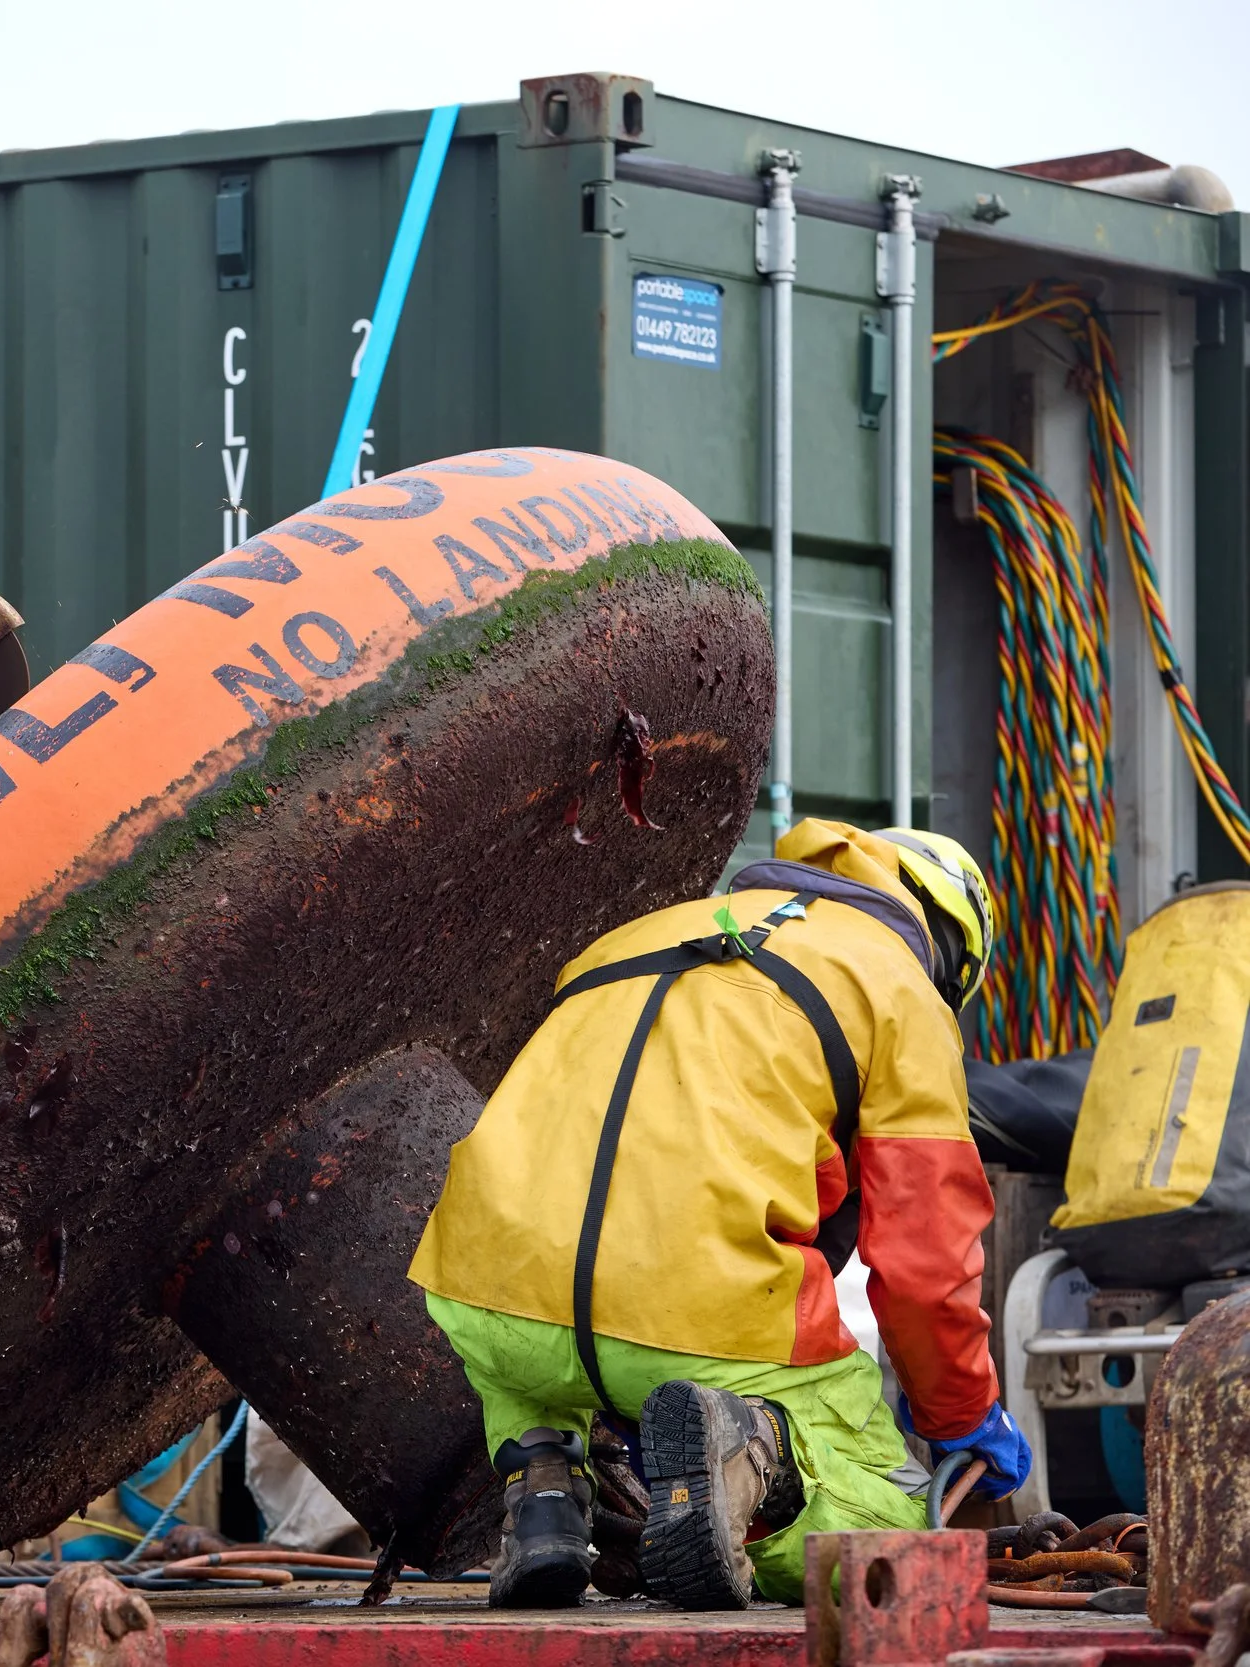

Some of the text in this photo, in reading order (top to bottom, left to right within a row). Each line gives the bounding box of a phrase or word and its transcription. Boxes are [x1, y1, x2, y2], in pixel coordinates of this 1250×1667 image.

[636, 315, 717, 349] 01449 782123
[211, 611, 358, 728] NO
[762, 1408, 785, 1462] CATERPILLAR
[669, 1487, 690, 1505] CAT
